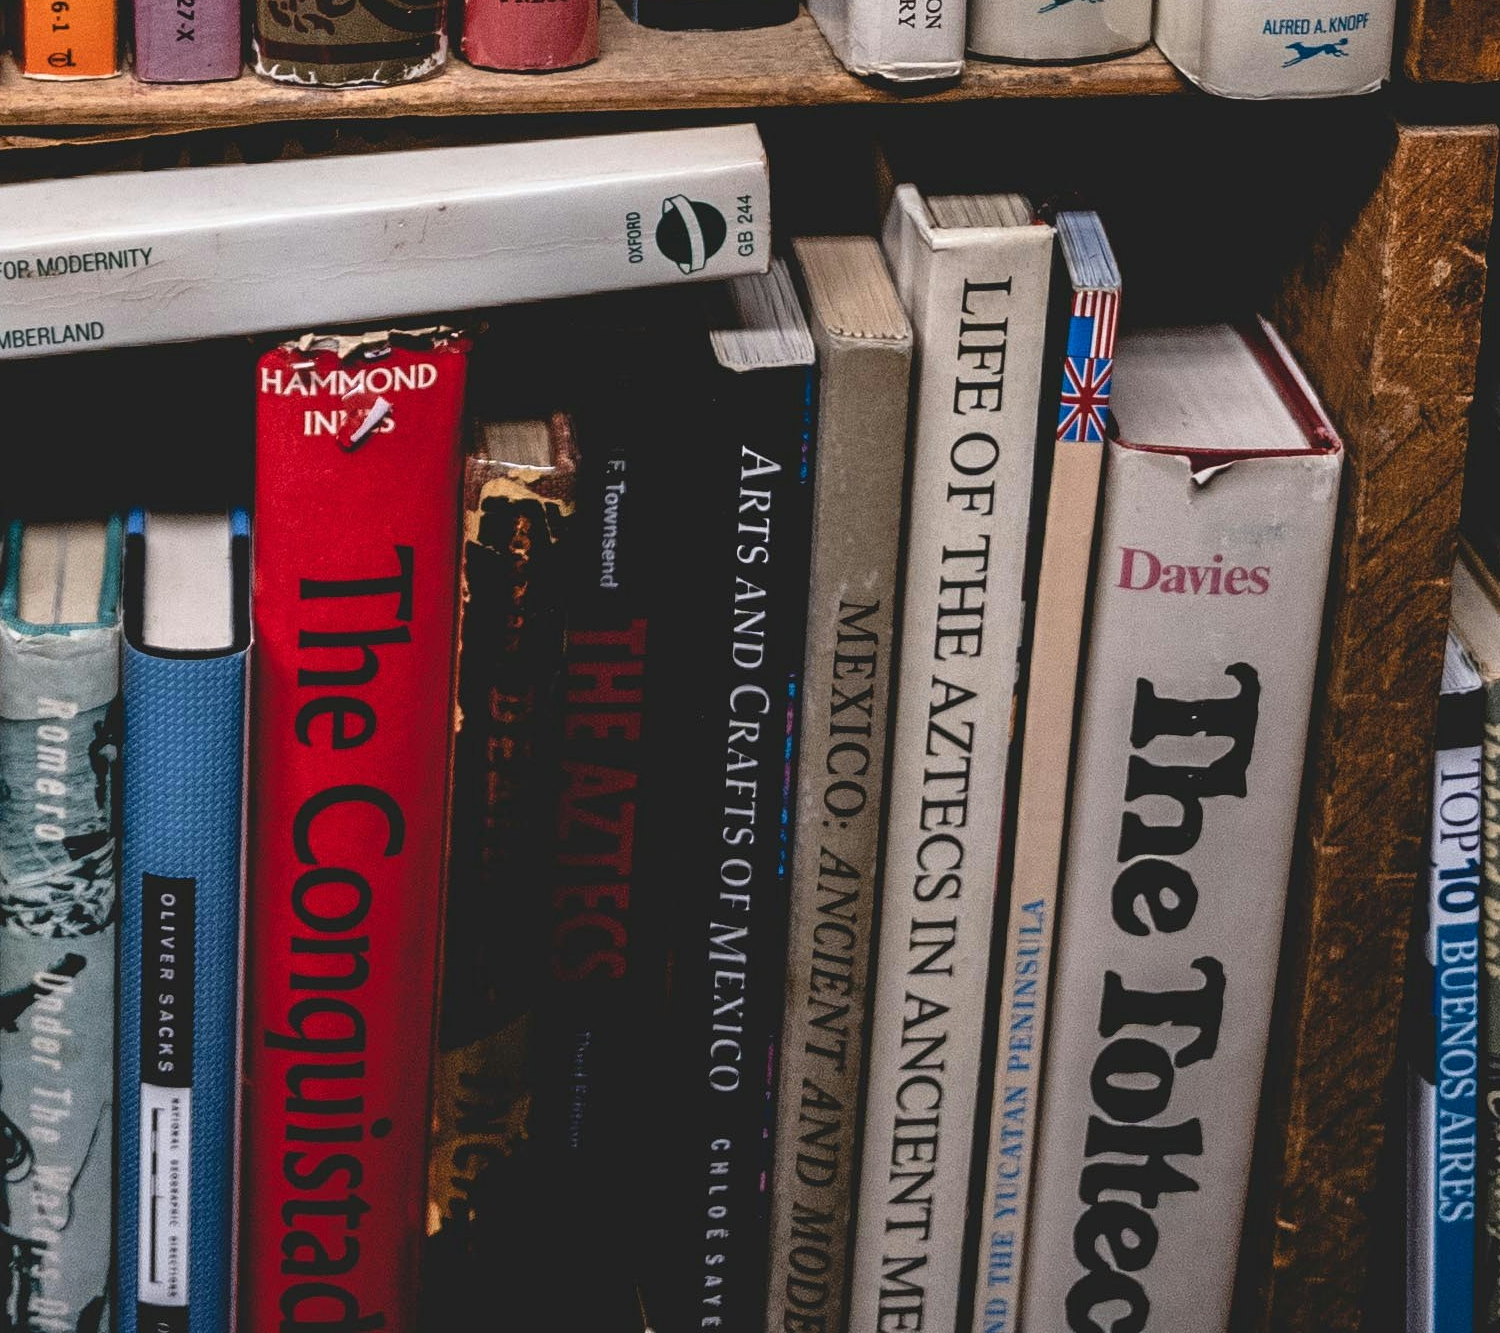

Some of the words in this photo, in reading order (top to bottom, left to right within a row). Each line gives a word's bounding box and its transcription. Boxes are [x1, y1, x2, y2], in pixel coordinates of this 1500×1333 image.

[35, 246, 153, 277] MODERNITY
[627, 211, 645, 266] OXFORD
[261, 365, 437, 398] HAMMOND
[953, 275, 1014, 415] LIFE
[945, 433, 998, 515] OF
[934, 535, 986, 659] THE
[1116, 547, 1271, 596] Davies
[916, 675, 979, 897] AZTECS
[1111, 662, 1262, 936] The
[1438, 753, 1483, 858] TOP
[1430, 864, 1481, 912] 10
[159, 894, 174, 984] OLIVER
[914, 918, 950, 975] IN
[157, 993, 173, 1073] SACKS
[1438, 933, 1481, 1092] BUENOS
[889, 996, 944, 1223] ANCIENT
[1436, 1101, 1476, 1221] AIRES
